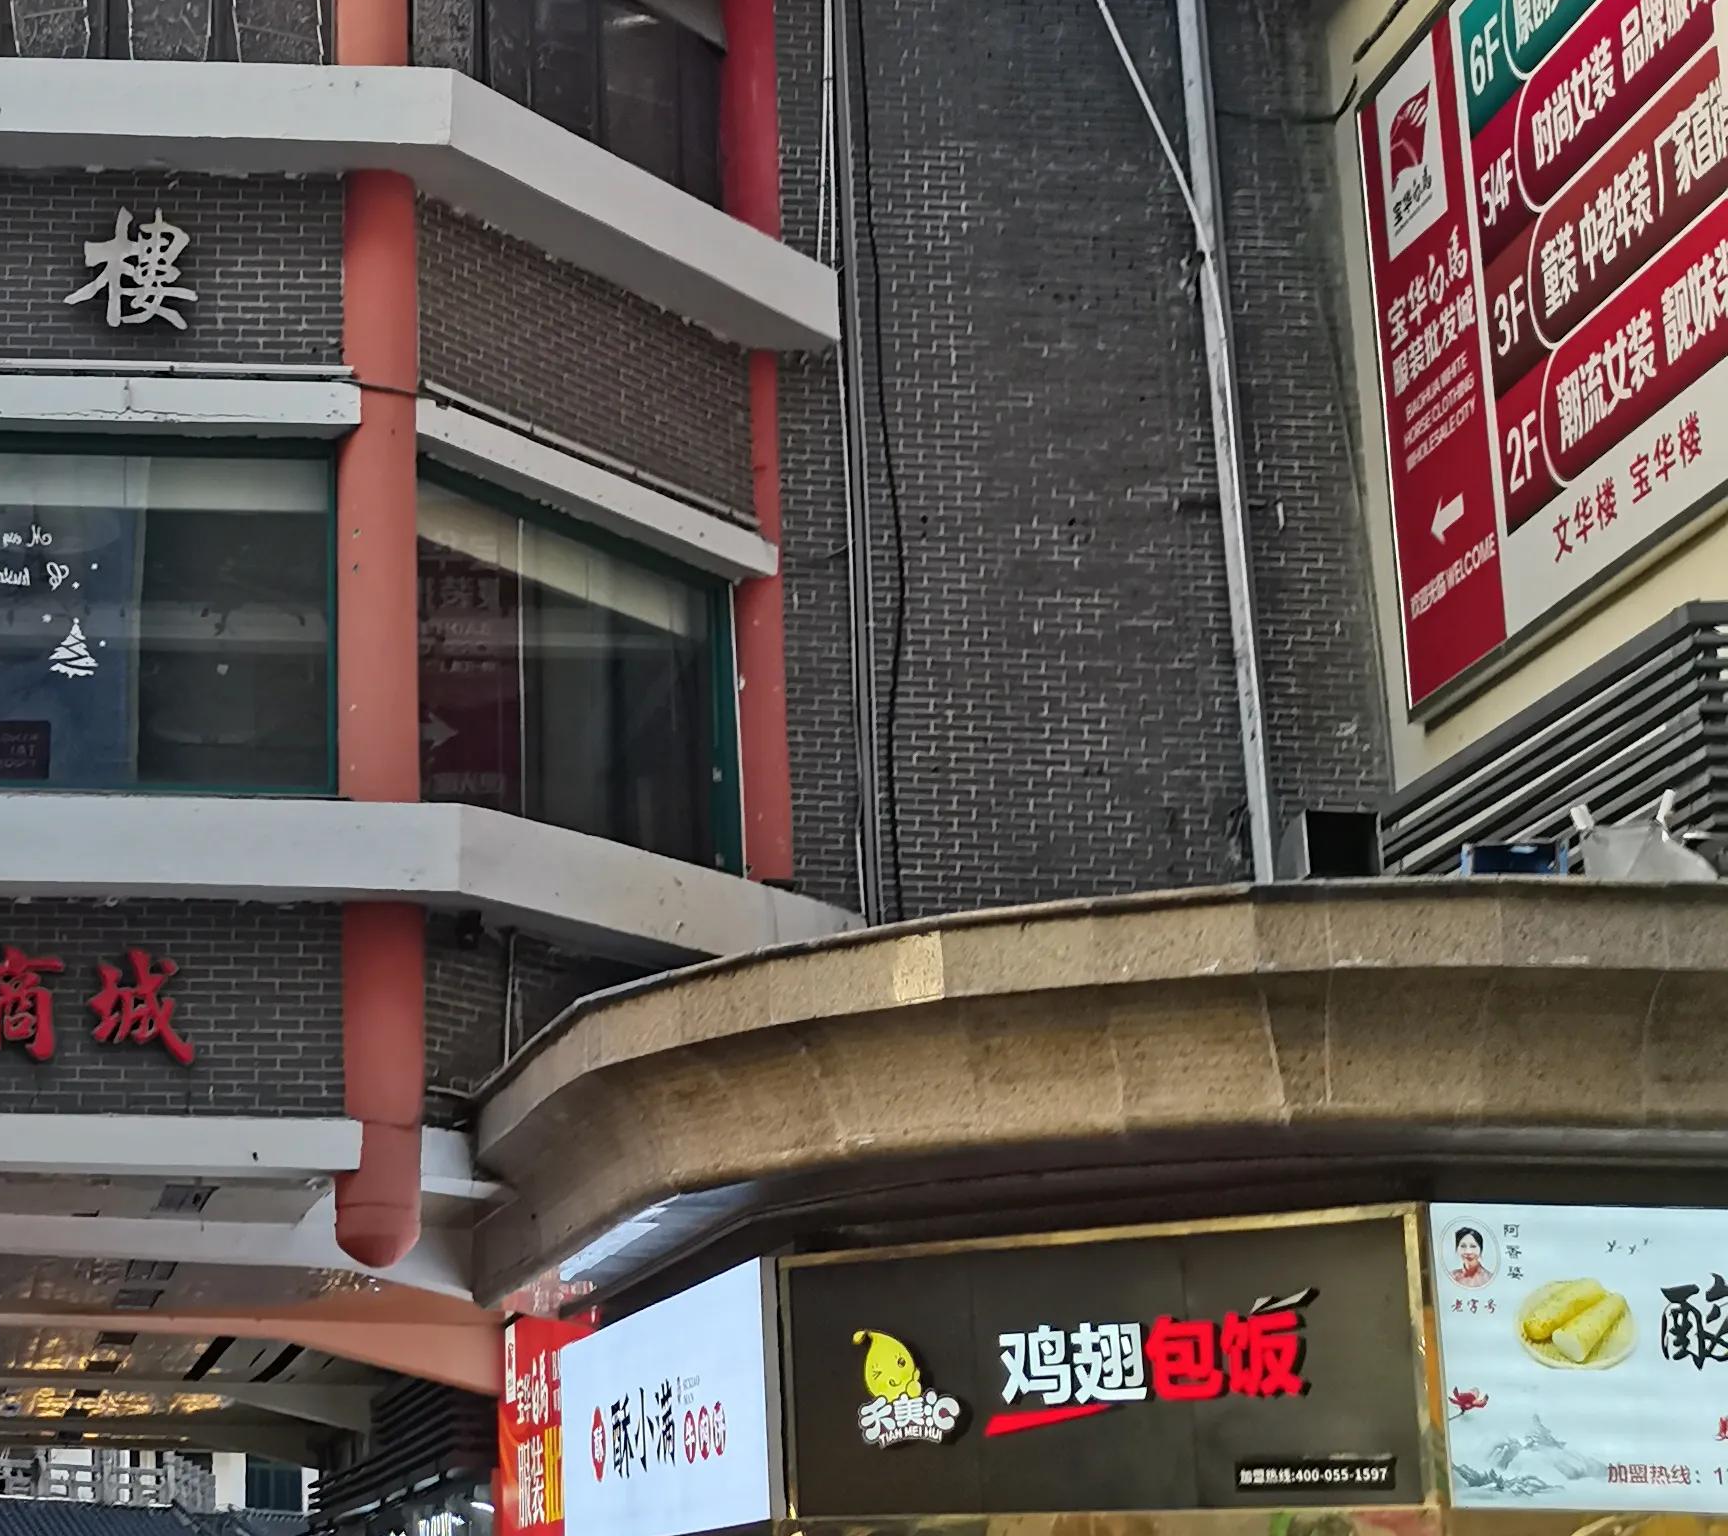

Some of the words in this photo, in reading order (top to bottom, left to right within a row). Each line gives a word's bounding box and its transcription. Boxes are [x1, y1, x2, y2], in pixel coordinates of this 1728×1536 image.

[1469, 13, 1501, 96] 6F
[1531, 36, 1617, 171] 时尚女装
[1480, 146, 1514, 227] 5/4F
[1539, 222, 1578, 320] 童装
[1578, 150, 1654, 282] 中老年装
[1387, 224, 1469, 351] 宝华白马
[1492, 273, 1527, 357] 3F
[1391, 283, 1477, 399] 服装批发城
[1555, 308, 1658, 455] 潮流女装
[1506, 409, 1538, 495] 2F
[1552, 476, 1618, 564] 文华楼
[1629, 410, 1704, 505] 宝华楼
[1446, 530, 1496, 594] WELCOME
[1451, 1298, 1498, 1314] 老字号
[998, 1310, 1306, 1406] 鸡翅包饭
[610, 1378, 677, 1480] 酥小满
[858, 1390, 961, 1432] 天美汇
[878, 1428, 905, 1445] TIAN
[905, 1426, 925, 1440] MEI
[925, 1427, 944, 1443] HUI
[1239, 1465, 1390, 1485] 加盟热线:400-055-1597
